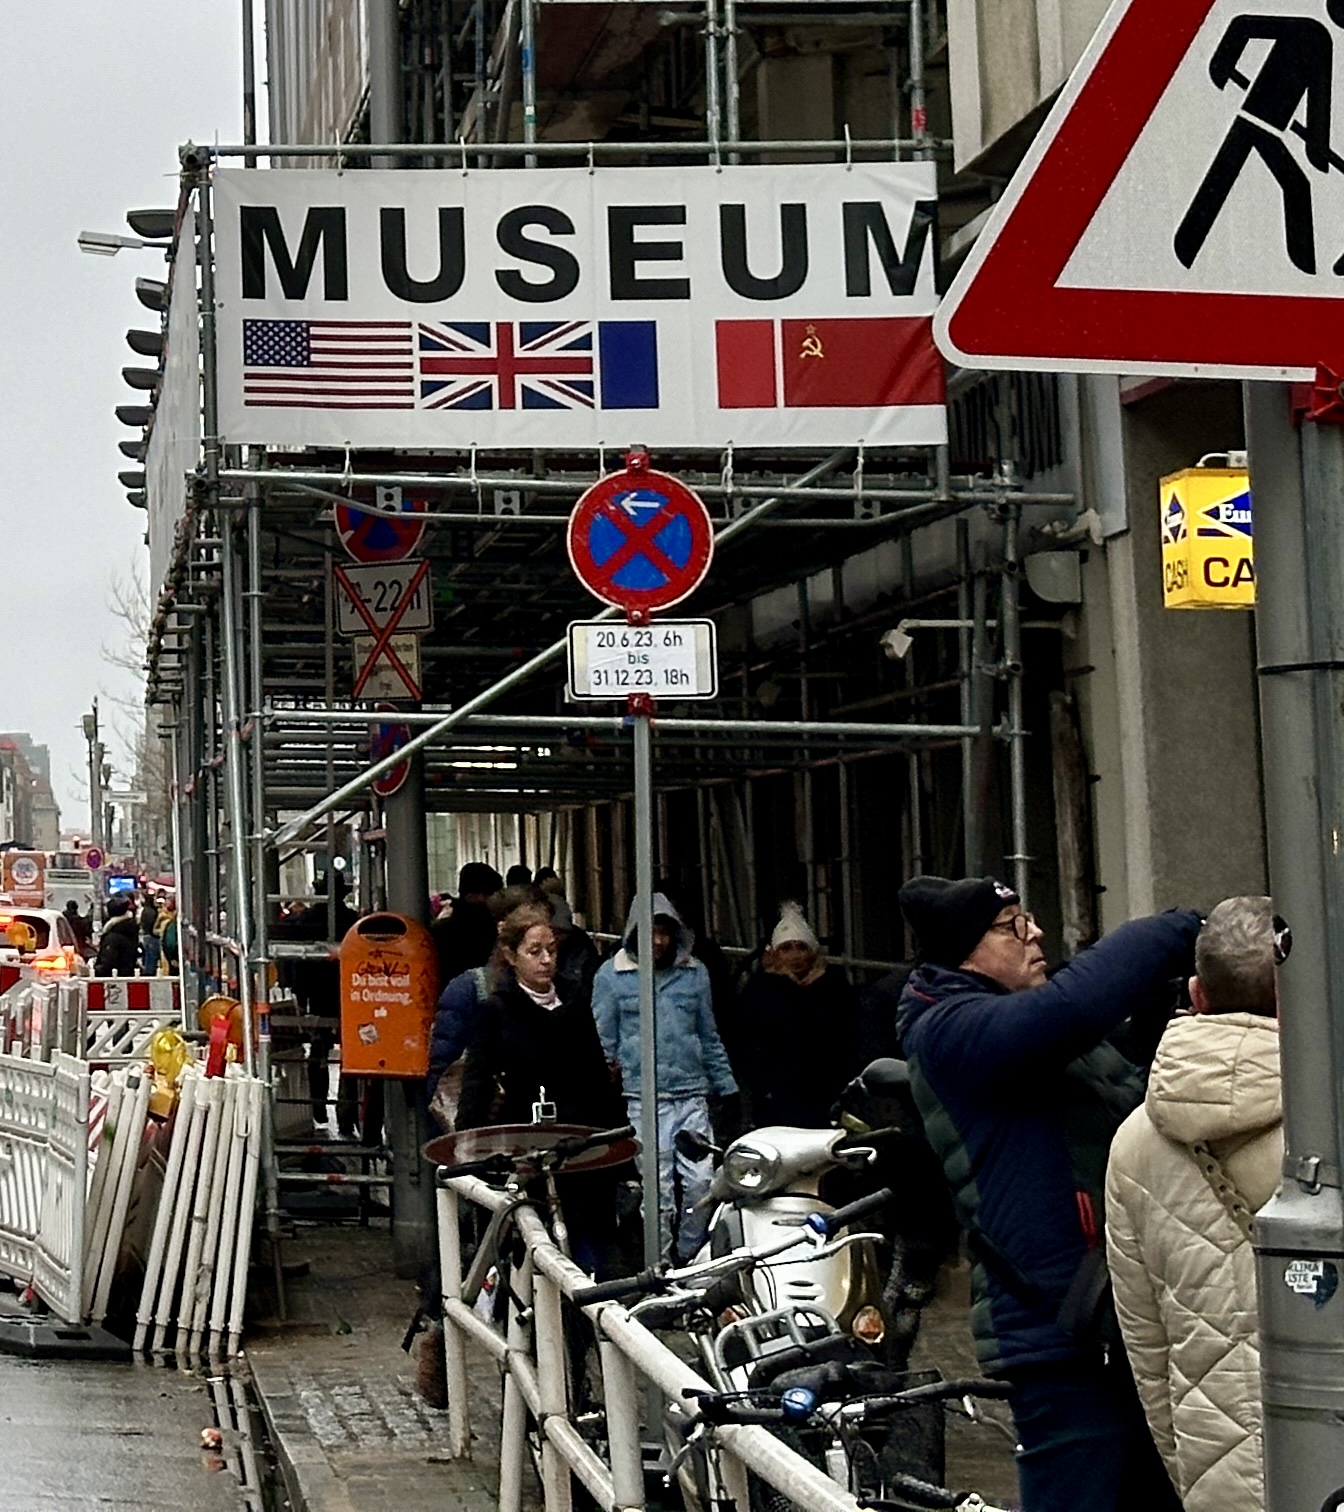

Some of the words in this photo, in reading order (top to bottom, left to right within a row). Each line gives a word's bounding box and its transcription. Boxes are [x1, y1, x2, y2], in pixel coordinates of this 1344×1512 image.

[238, 198, 938, 305] MUSEUM
[663, 631, 683, 647] 6h
[628, 653, 650, 665] bis
[664, 669, 690, 686] 18h
